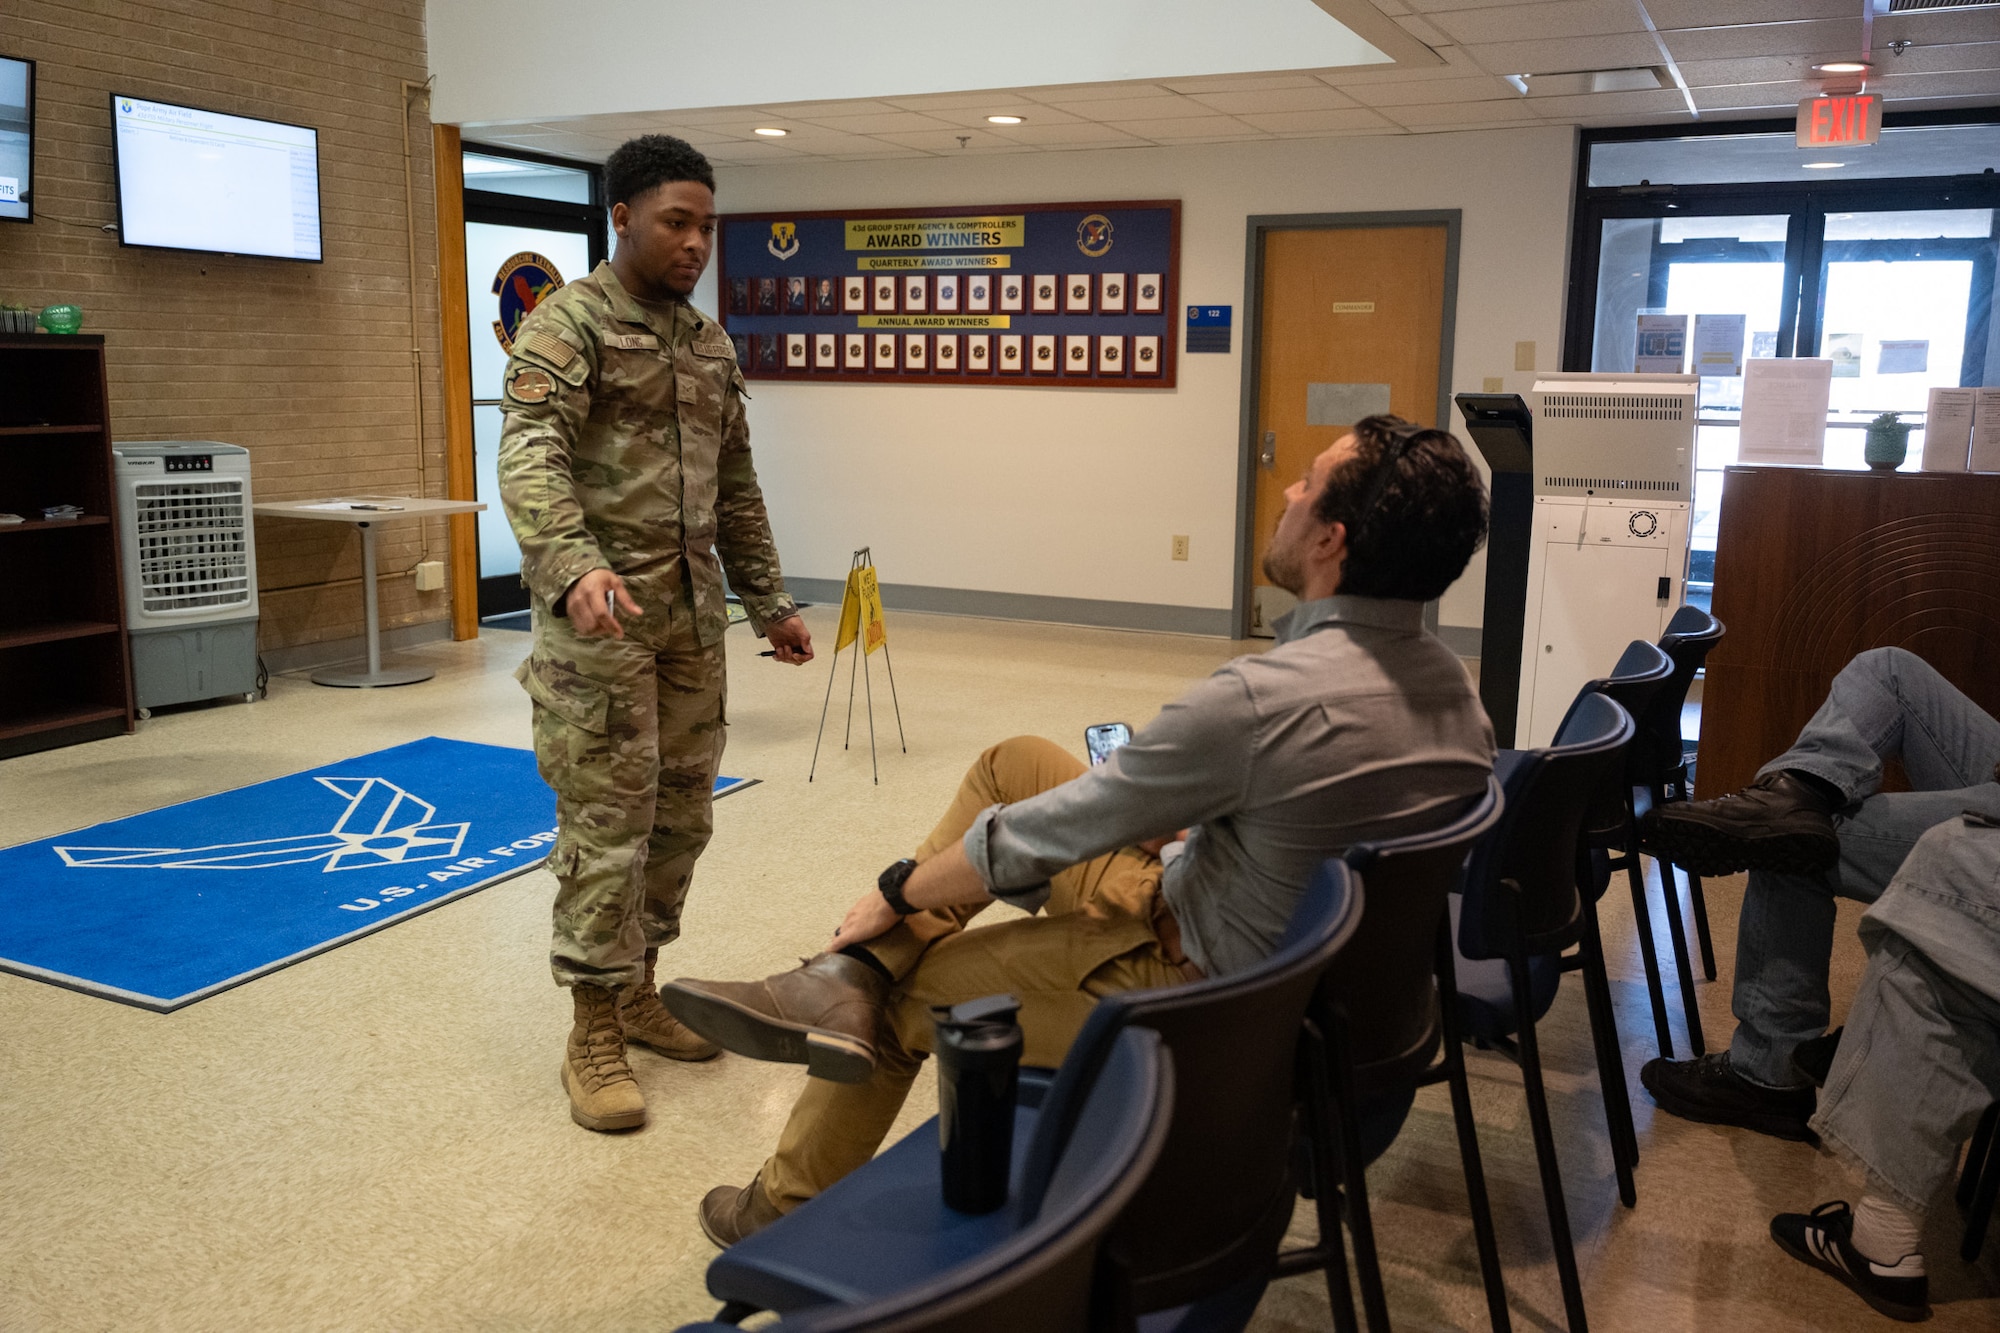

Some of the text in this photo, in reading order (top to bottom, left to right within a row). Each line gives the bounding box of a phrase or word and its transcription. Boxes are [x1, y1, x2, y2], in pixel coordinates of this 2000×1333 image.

[136, 103, 192, 119] Pope Army Air Field
[1810, 96, 1873, 144] EXIT
[852, 224, 866, 232] 43d
[867, 224, 892, 232] GROUP
[893, 223, 916, 231] STAFF
[917, 223, 947, 231] AGENCY
[956, 221, 1016, 230] COMPTROLLERS
[867, 232, 1001, 248] AWARD WINNERS
[498, 254, 534, 280] RESOURCING
[869, 257, 998, 269] QUARTERLY AWARD WINNERS
[877, 317, 990, 326] ANNUAL AWARD WINNERS
[619, 336, 643, 348] LONG
[338, 883, 429, 912] U.S.
[427, 857, 498, 882] AIR
